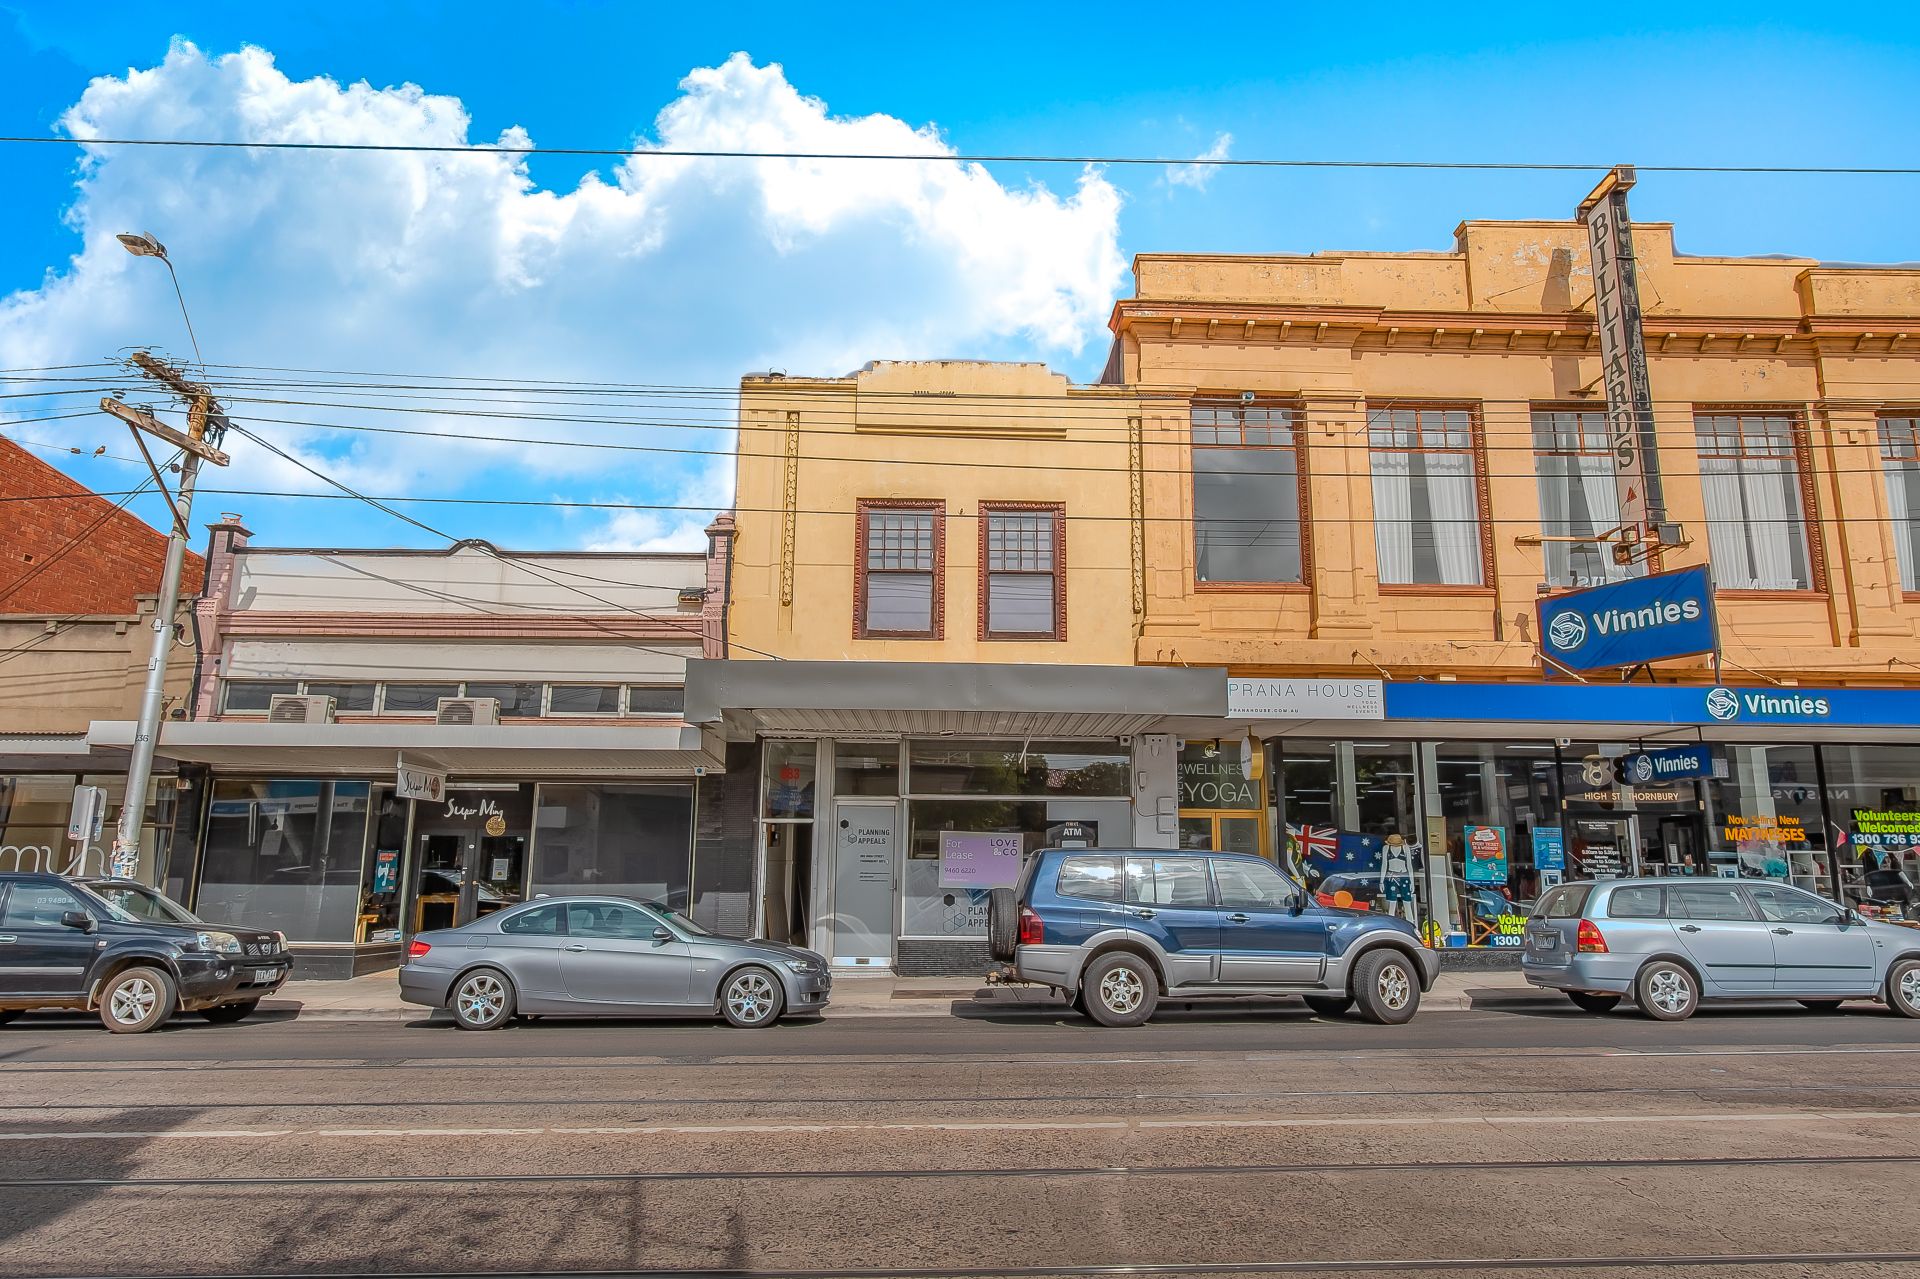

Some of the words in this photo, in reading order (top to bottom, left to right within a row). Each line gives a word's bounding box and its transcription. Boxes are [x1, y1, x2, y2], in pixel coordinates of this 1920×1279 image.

[1591, 211, 1635, 471] BILLIARDS
[1593, 600, 1700, 635] Vinnies
[1229, 683, 1296, 697] PRANA
[1307, 684, 1377, 698] HOUSE
[1744, 694, 1829, 715] Vinnies
[1183, 763, 1243, 775] WELLNES
[1654, 754, 1699, 773] Vinnies
[404, 771, 423, 796] Super
[1184, 782, 1254, 802] YOGA
[1584, 792, 1607, 800] HIGH
[1628, 792, 1679, 800] THORNBURY
[443, 798, 478, 820] Super
[479, 799, 504, 821] Ming
[1727, 814, 1749, 825] Now
[1779, 815, 1800, 825] New
[1853, 810, 1920, 821] Volunteers
[1063, 828, 1082, 836] ATM
[1857, 822, 1920, 833] Welcomed
[1724, 827, 1806, 841] MATTRESSES
[1852, 833, 1881, 844] 1300
[1883, 834, 1907, 844] 736
[946, 839, 962, 848] For
[990, 838, 1018, 847] LOVE
[945, 850, 973, 860] Lease
[968, 906, 989, 915] PLAN
[967, 919, 988, 927] APPE
[1493, 936, 1521, 945] 1300
